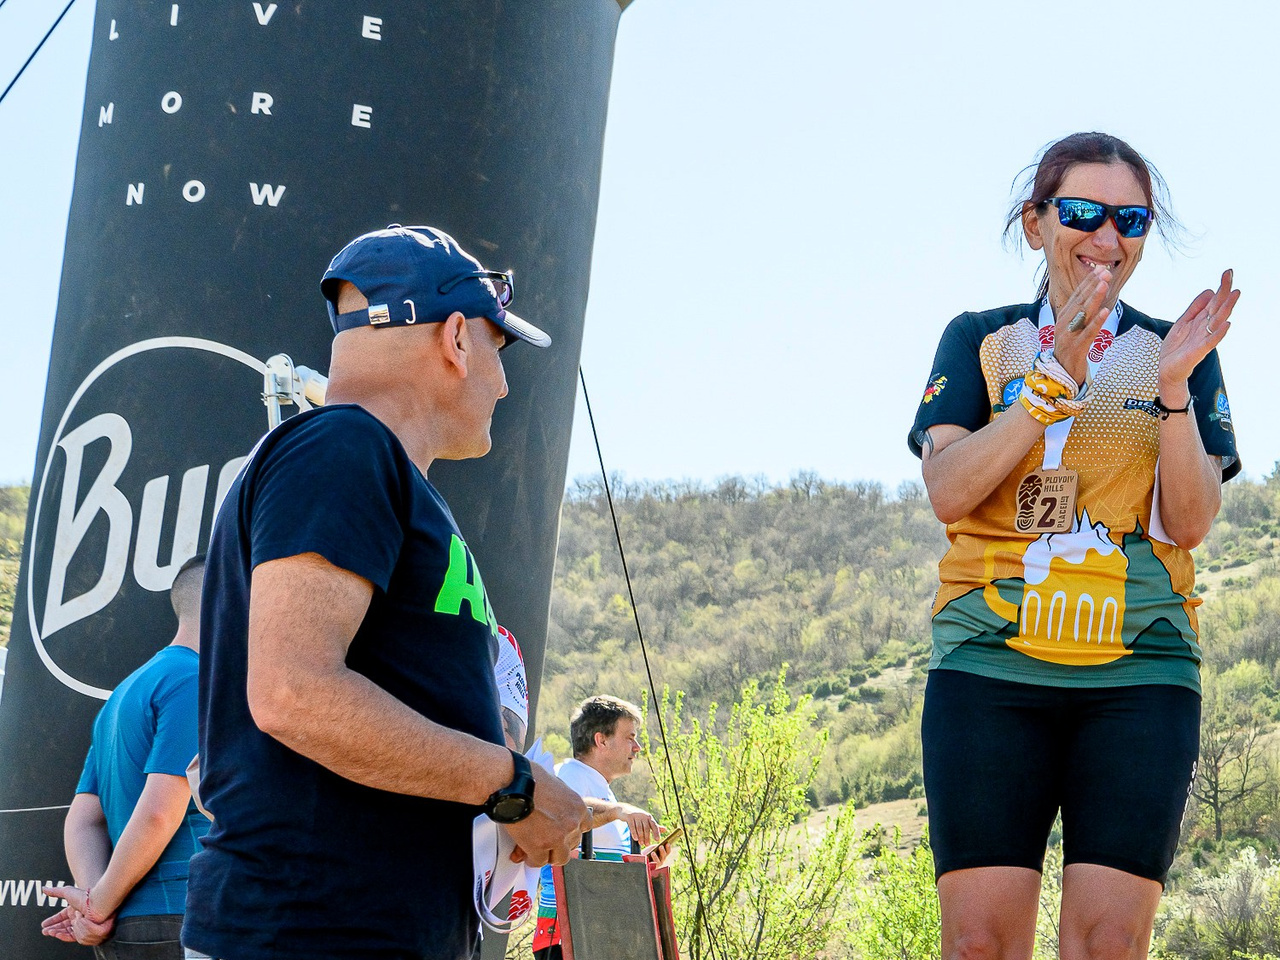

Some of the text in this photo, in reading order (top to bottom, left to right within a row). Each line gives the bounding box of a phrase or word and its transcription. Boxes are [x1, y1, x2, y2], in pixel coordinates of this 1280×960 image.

[126, 179, 286, 207] NOW
[1044, 475, 1075, 484] PLOVDIV
[1043, 485, 1064, 493] HILLS
[1037, 497, 1057, 528] 2
